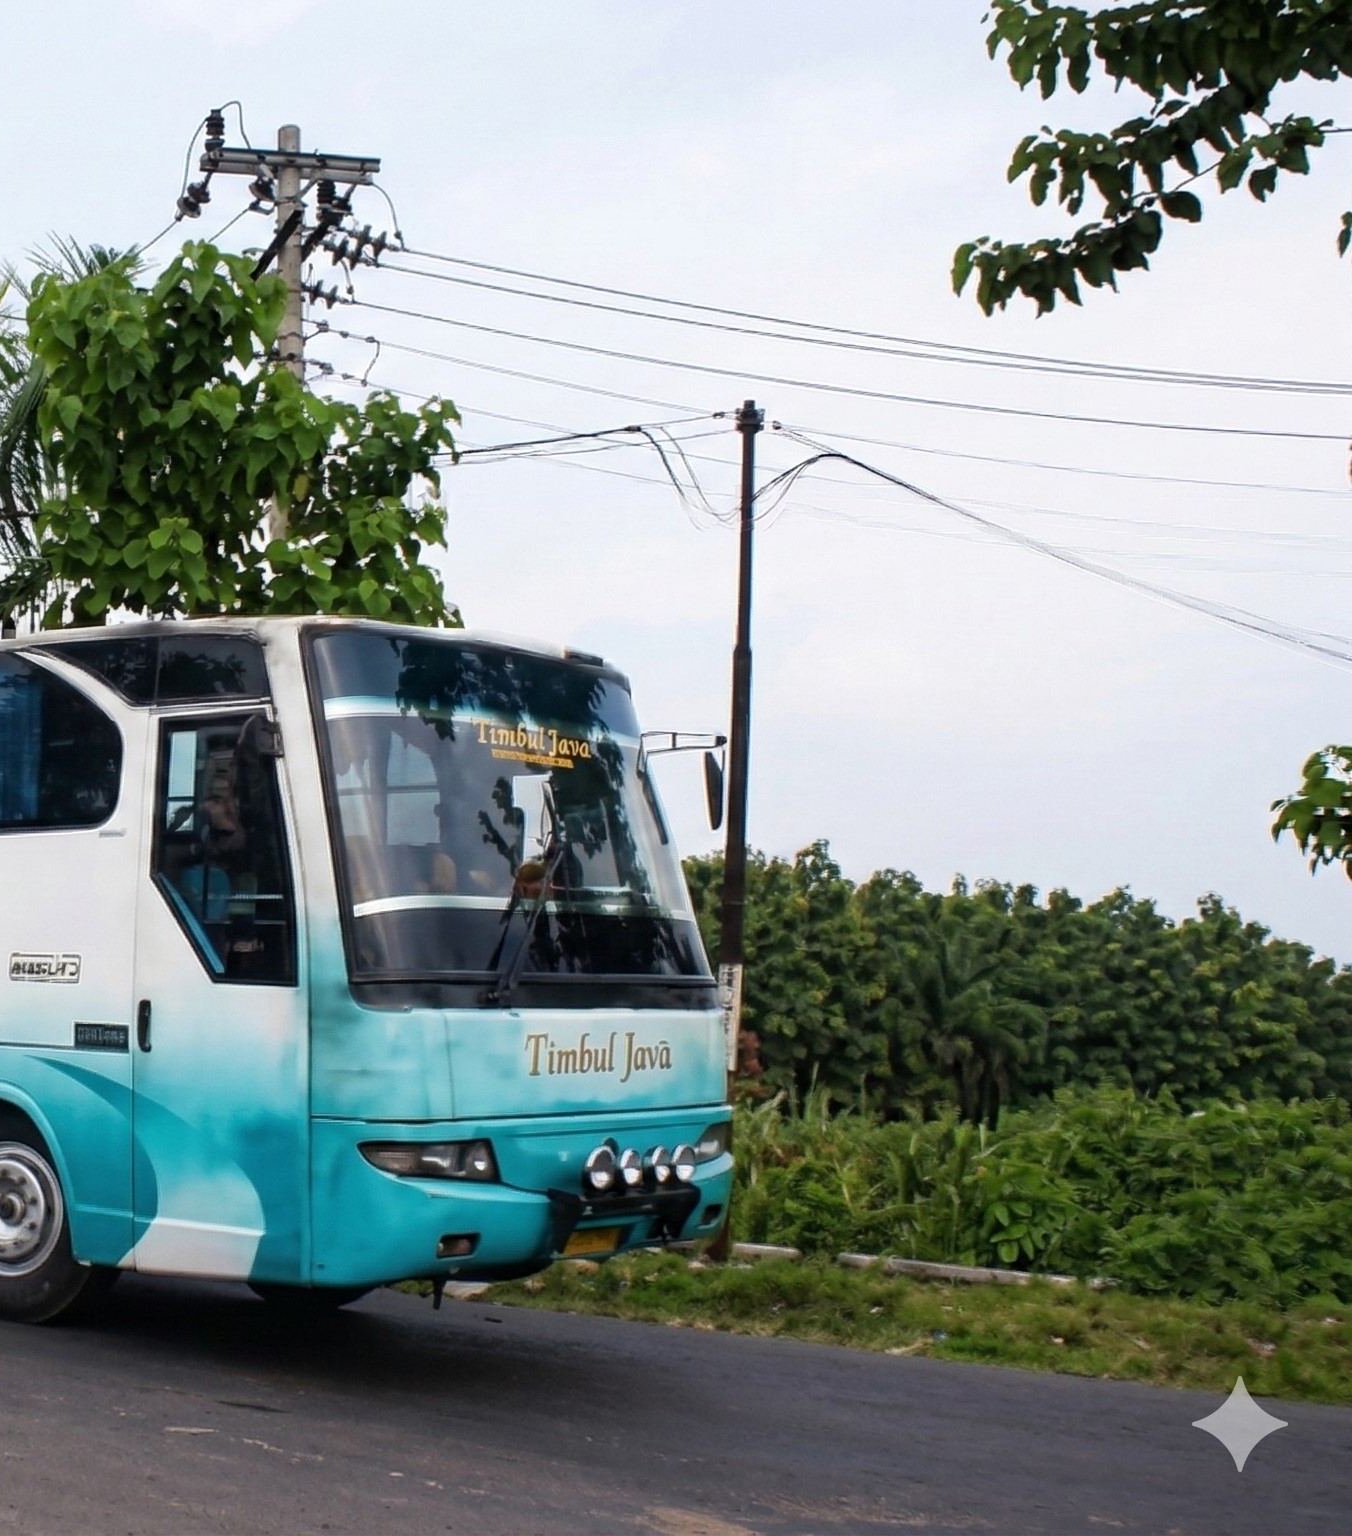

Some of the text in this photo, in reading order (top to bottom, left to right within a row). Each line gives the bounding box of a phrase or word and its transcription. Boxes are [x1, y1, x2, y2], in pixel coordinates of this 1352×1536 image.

[471, 717, 592, 758] Timbul Java
[524, 1031, 617, 1077] Timbul
